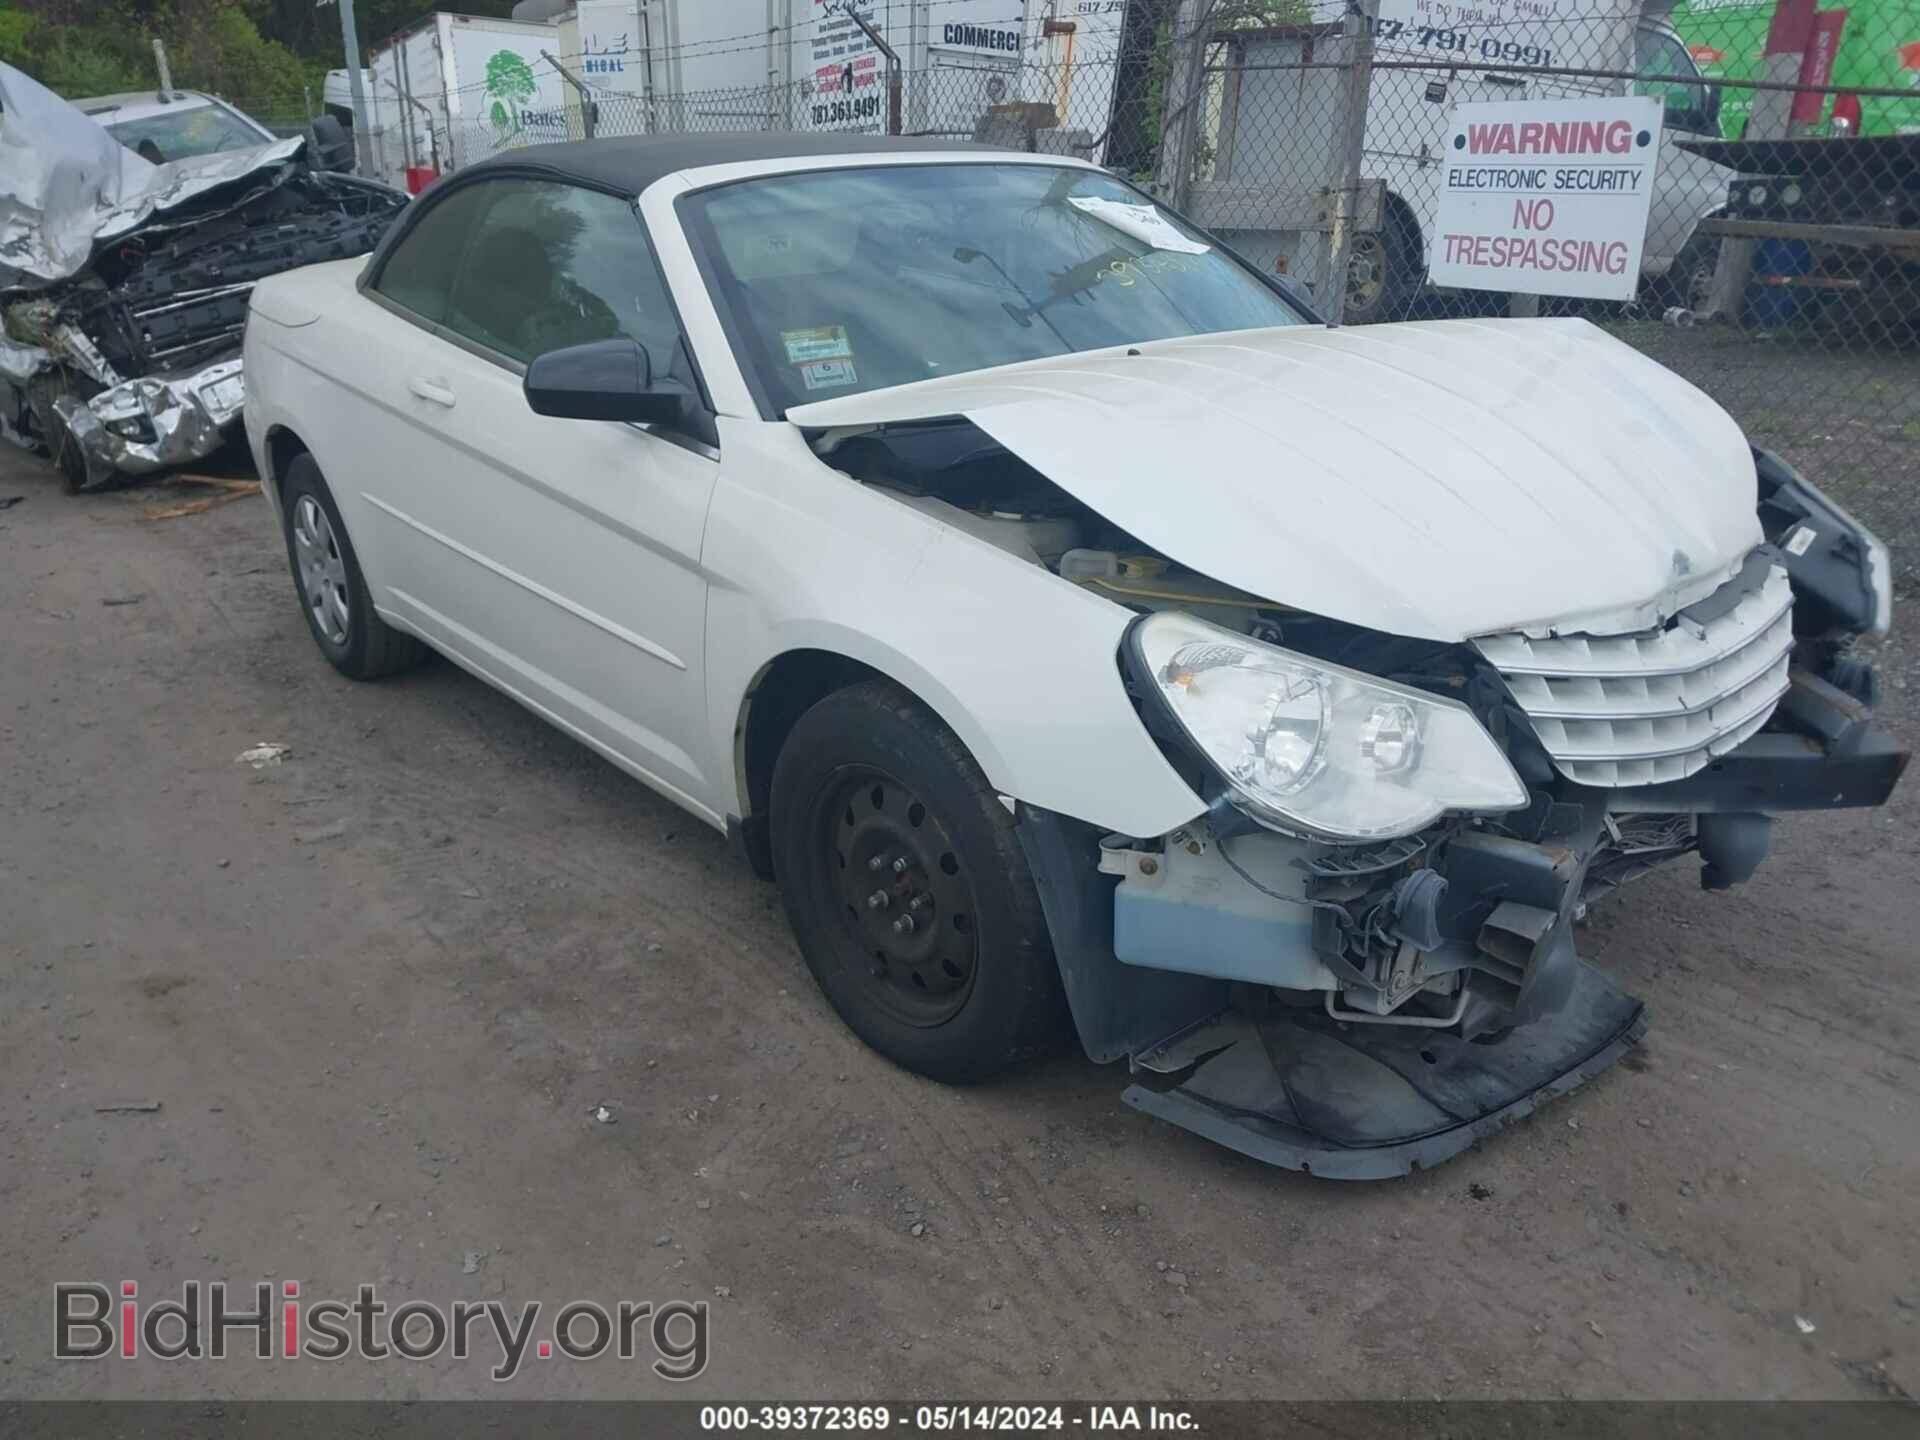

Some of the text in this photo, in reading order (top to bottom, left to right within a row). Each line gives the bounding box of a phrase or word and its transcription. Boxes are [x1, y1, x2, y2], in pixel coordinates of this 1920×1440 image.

[1468, 120, 1633, 154] WARNING
[1448, 168, 1642, 190] ELECTRONIC SECURITY
[1512, 198, 1555, 231] NO
[1443, 234, 1628, 275] TRESPASSING
